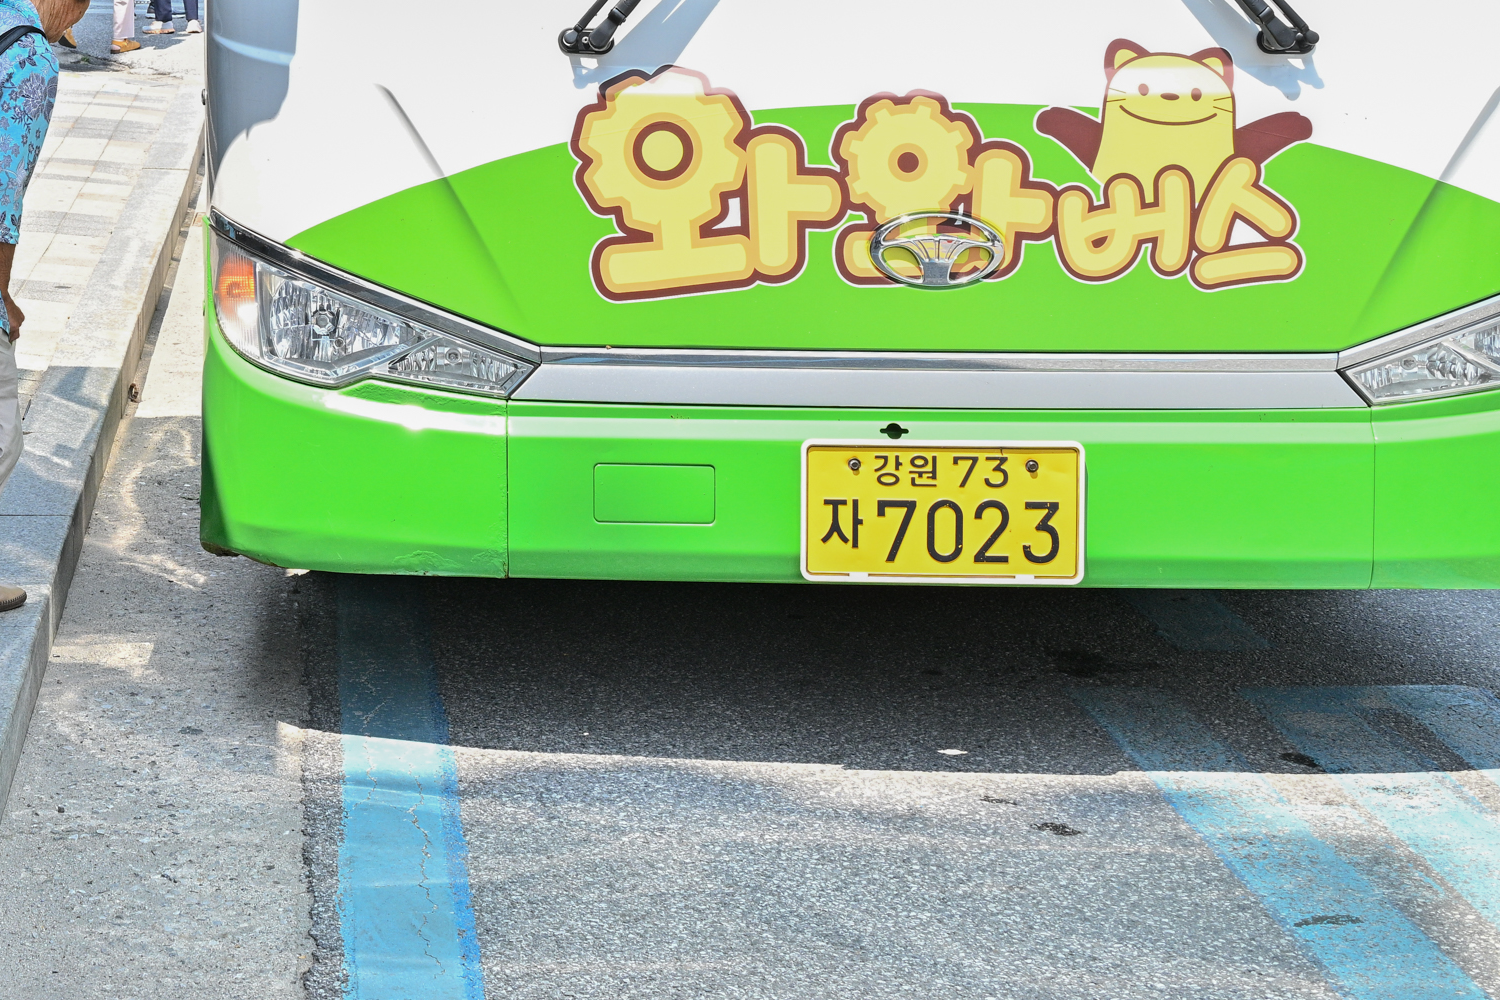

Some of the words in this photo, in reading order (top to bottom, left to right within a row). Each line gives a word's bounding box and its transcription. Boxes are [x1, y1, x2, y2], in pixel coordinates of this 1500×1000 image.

[578, 68, 1303, 300] 와와버스
[873, 454, 938, 488] 강원
[952, 456, 1009, 488] 73
[820, 498, 1060, 564] 자7023
